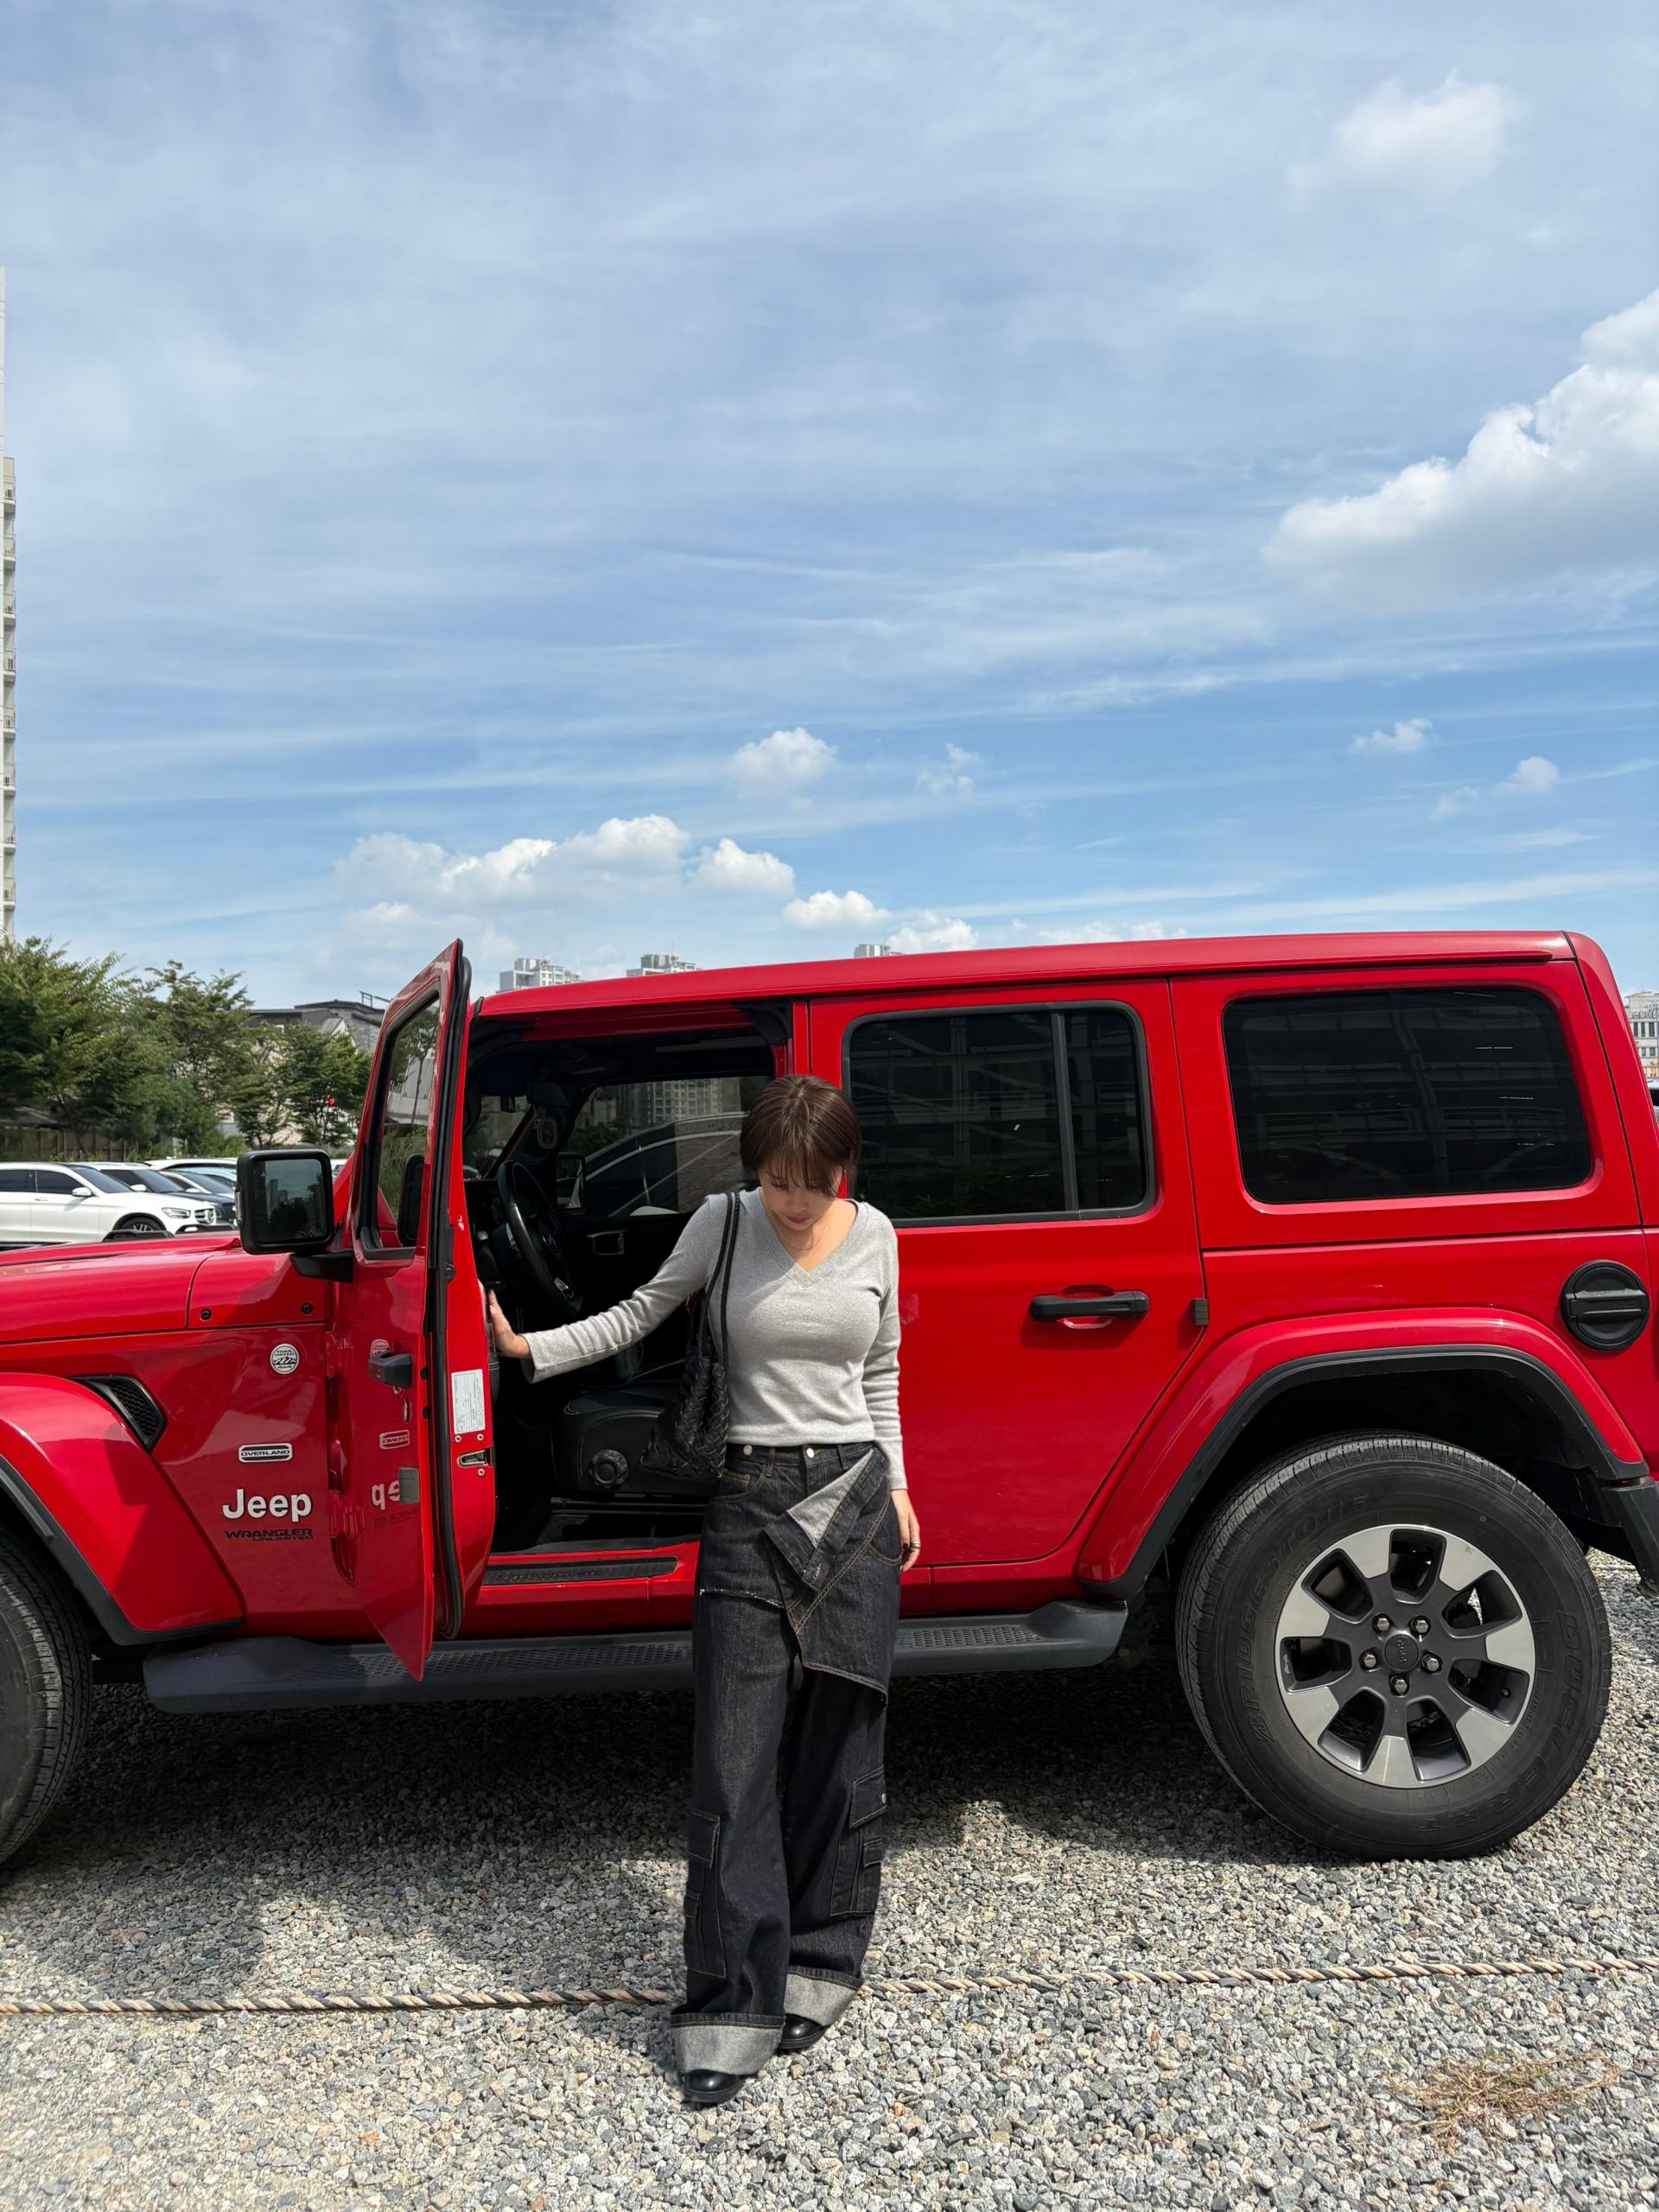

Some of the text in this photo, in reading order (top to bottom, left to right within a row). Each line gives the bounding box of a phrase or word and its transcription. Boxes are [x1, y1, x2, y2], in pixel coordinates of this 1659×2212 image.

[222, 1488, 312, 1522] Jeep
[224, 1529, 313, 1539] WRANGLER
[1236, 1491, 1370, 1741] BRIDGESTONE
